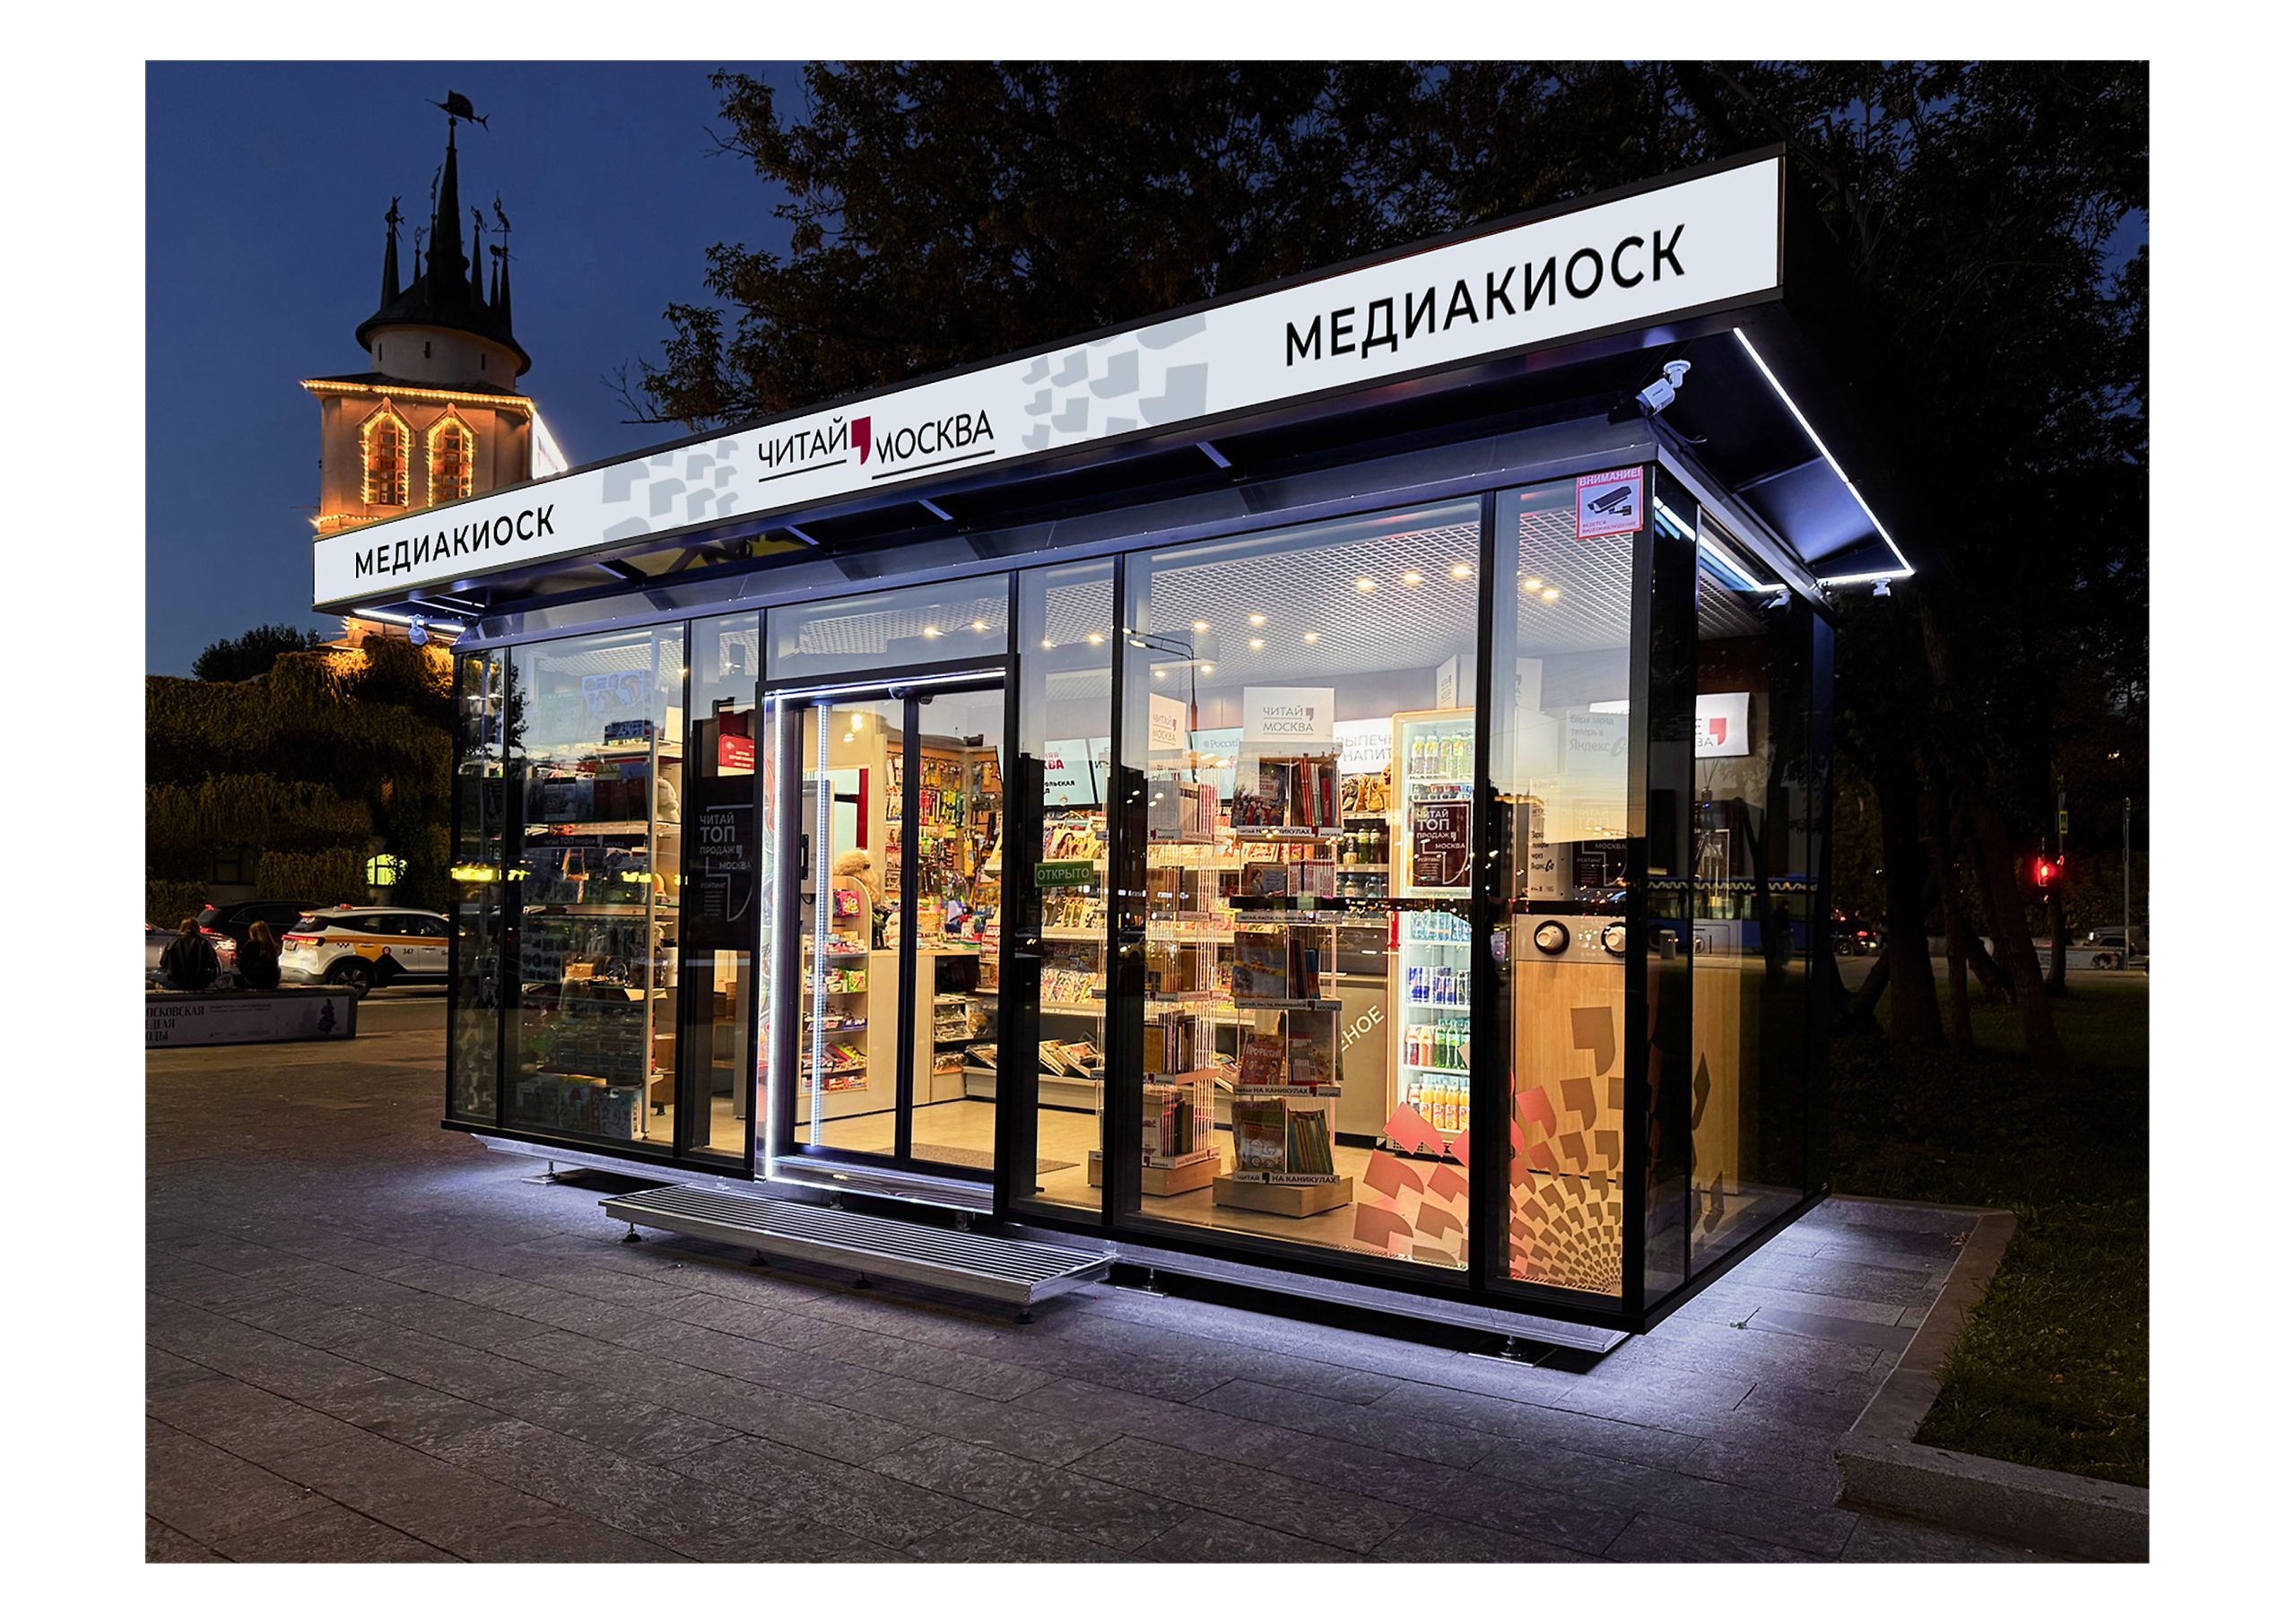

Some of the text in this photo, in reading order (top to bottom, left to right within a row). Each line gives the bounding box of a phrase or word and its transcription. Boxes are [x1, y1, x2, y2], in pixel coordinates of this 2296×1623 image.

[1285, 223, 1686, 367] МЕДИАКИОСК
[758, 415, 848, 468] ЧИТАЙ
[875, 409, 994, 464] МОСКВА
[1579, 467, 1642, 487] ВНИМАНИЕ!
[355, 504, 554, 579] МЕДИАКИОСК
[1263, 705, 1303, 716] ЧИТАЙ
[1263, 722, 1314, 732] МОСКВА
[1570, 738, 1611, 753] Яндекс
[1343, 747, 1392, 762] НАПИТ
[700, 812, 735, 825] ЧИТАЙ
[1416, 809, 1448, 819] ЧИТАЙ
[1417, 818, 1449, 831] ТОП
[700, 826, 735, 843] ТОП
[700, 846, 735, 855] ПРОДАЖ
[719, 861, 752, 870] МОСКВА
[1037, 867, 1090, 881] ОТКРЫТО
[146, 1005, 204, 1019] ОСКОВСКАЯ
[145, 1019, 176, 1030] ЕДЕЛЯ
[145, 1030, 169, 1042] ОДЫ
[1286, 1176, 1337, 1184] КАНИКУЛАХ
